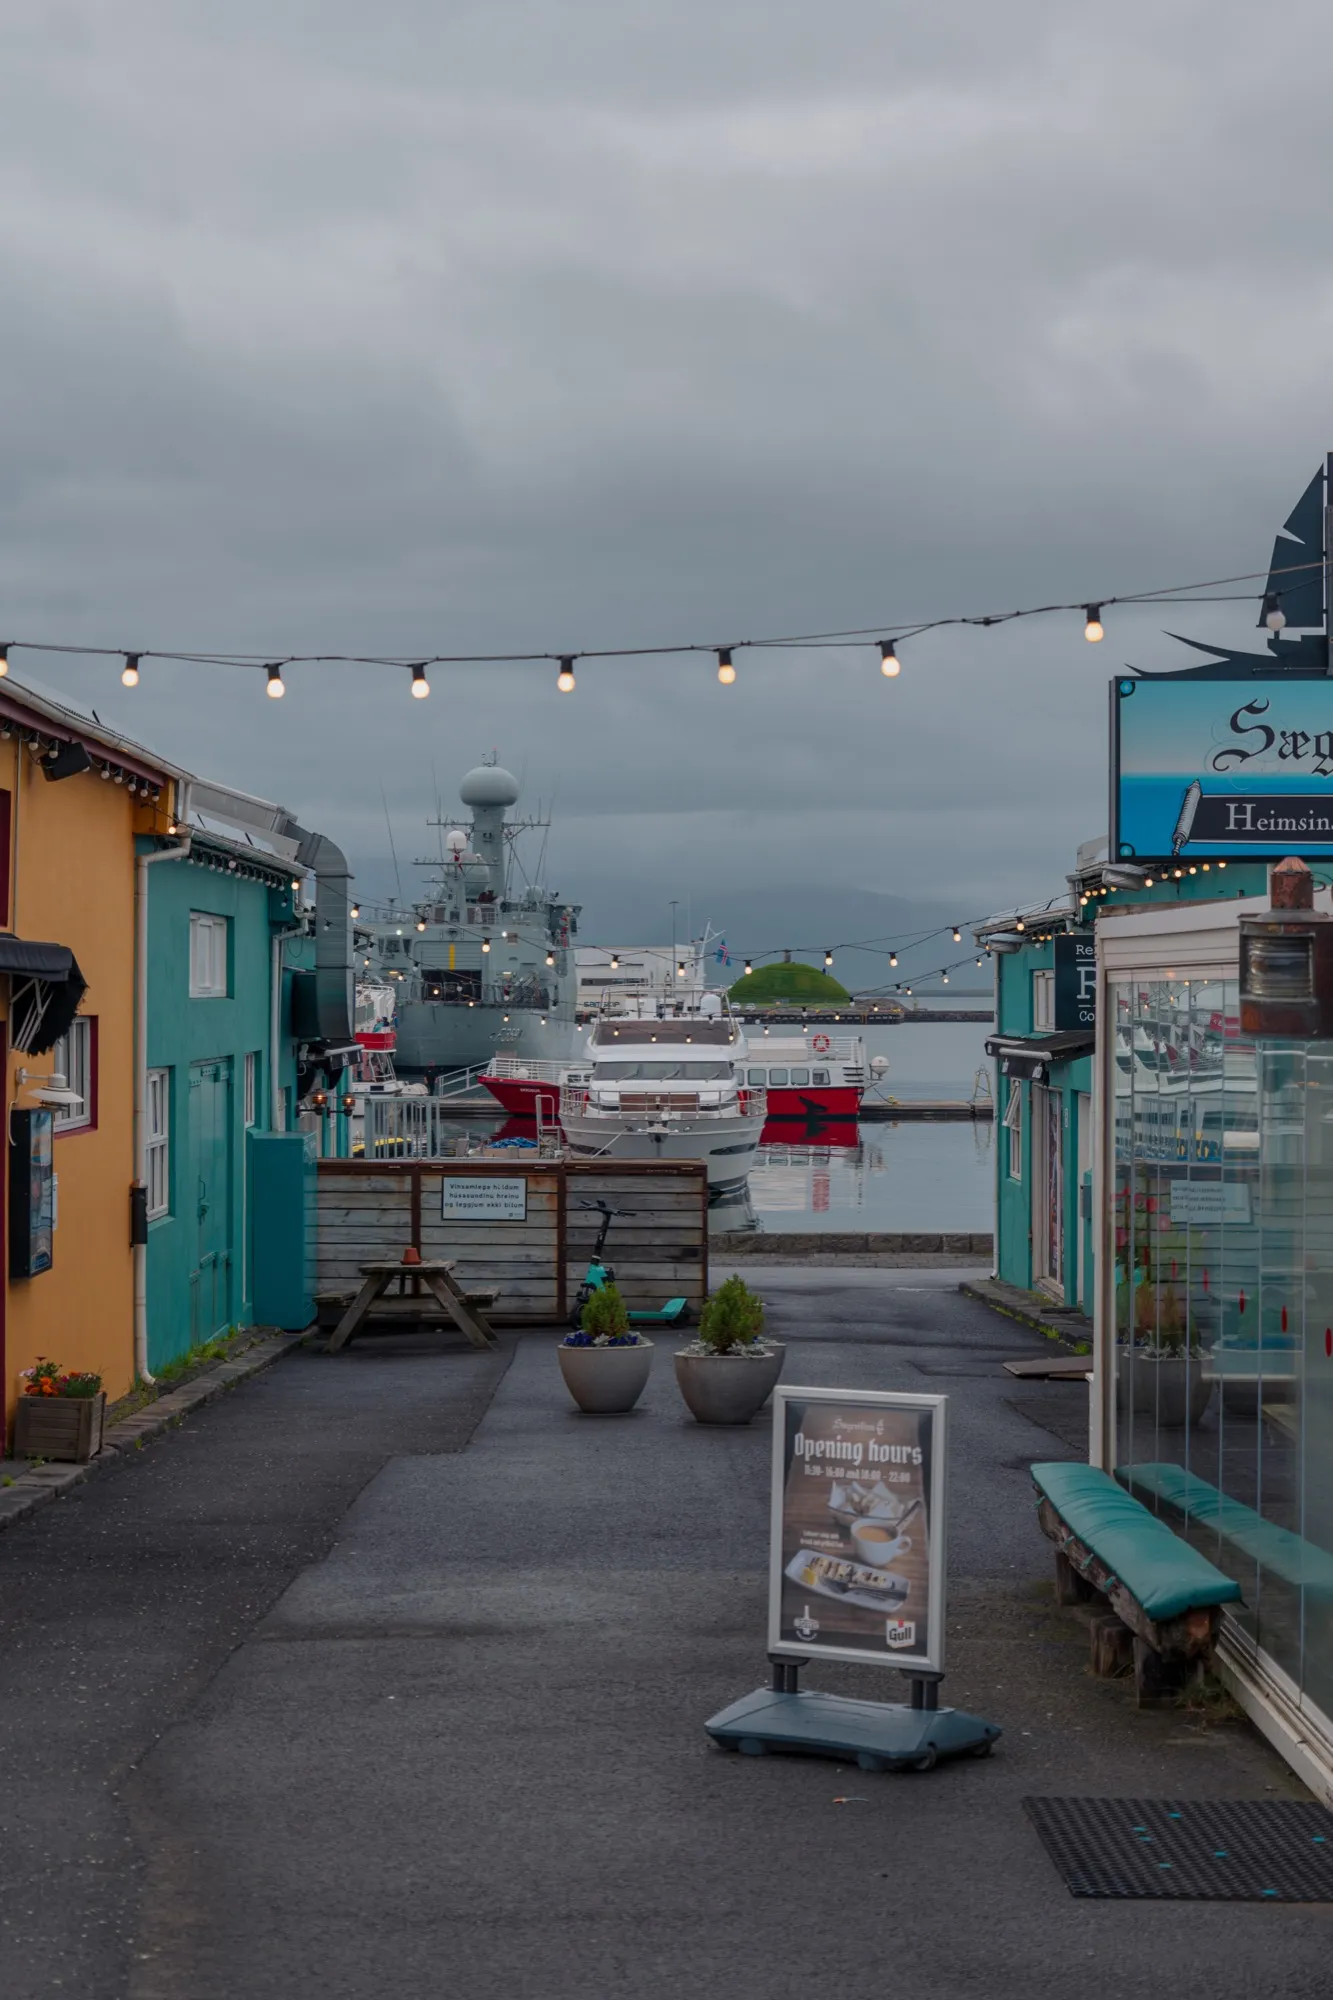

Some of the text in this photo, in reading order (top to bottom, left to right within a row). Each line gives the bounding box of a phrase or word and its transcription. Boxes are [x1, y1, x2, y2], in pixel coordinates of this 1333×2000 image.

[1212, 696, 1333, 777] Sæg
[1224, 803, 1333, 832] Heimsin
[1075, 944, 1096, 956] Re
[449, 1183, 491, 1191] Vinsamlega
[496, 1191, 520, 1199] hreinu
[456, 1201, 485, 1209] leggjum
[794, 1432, 923, 1467] Opening hours
[845, 1468, 860, 1479] and
[888, 1471, 911, 1484] 22:00
[889, 1626, 912, 1643] Gull
